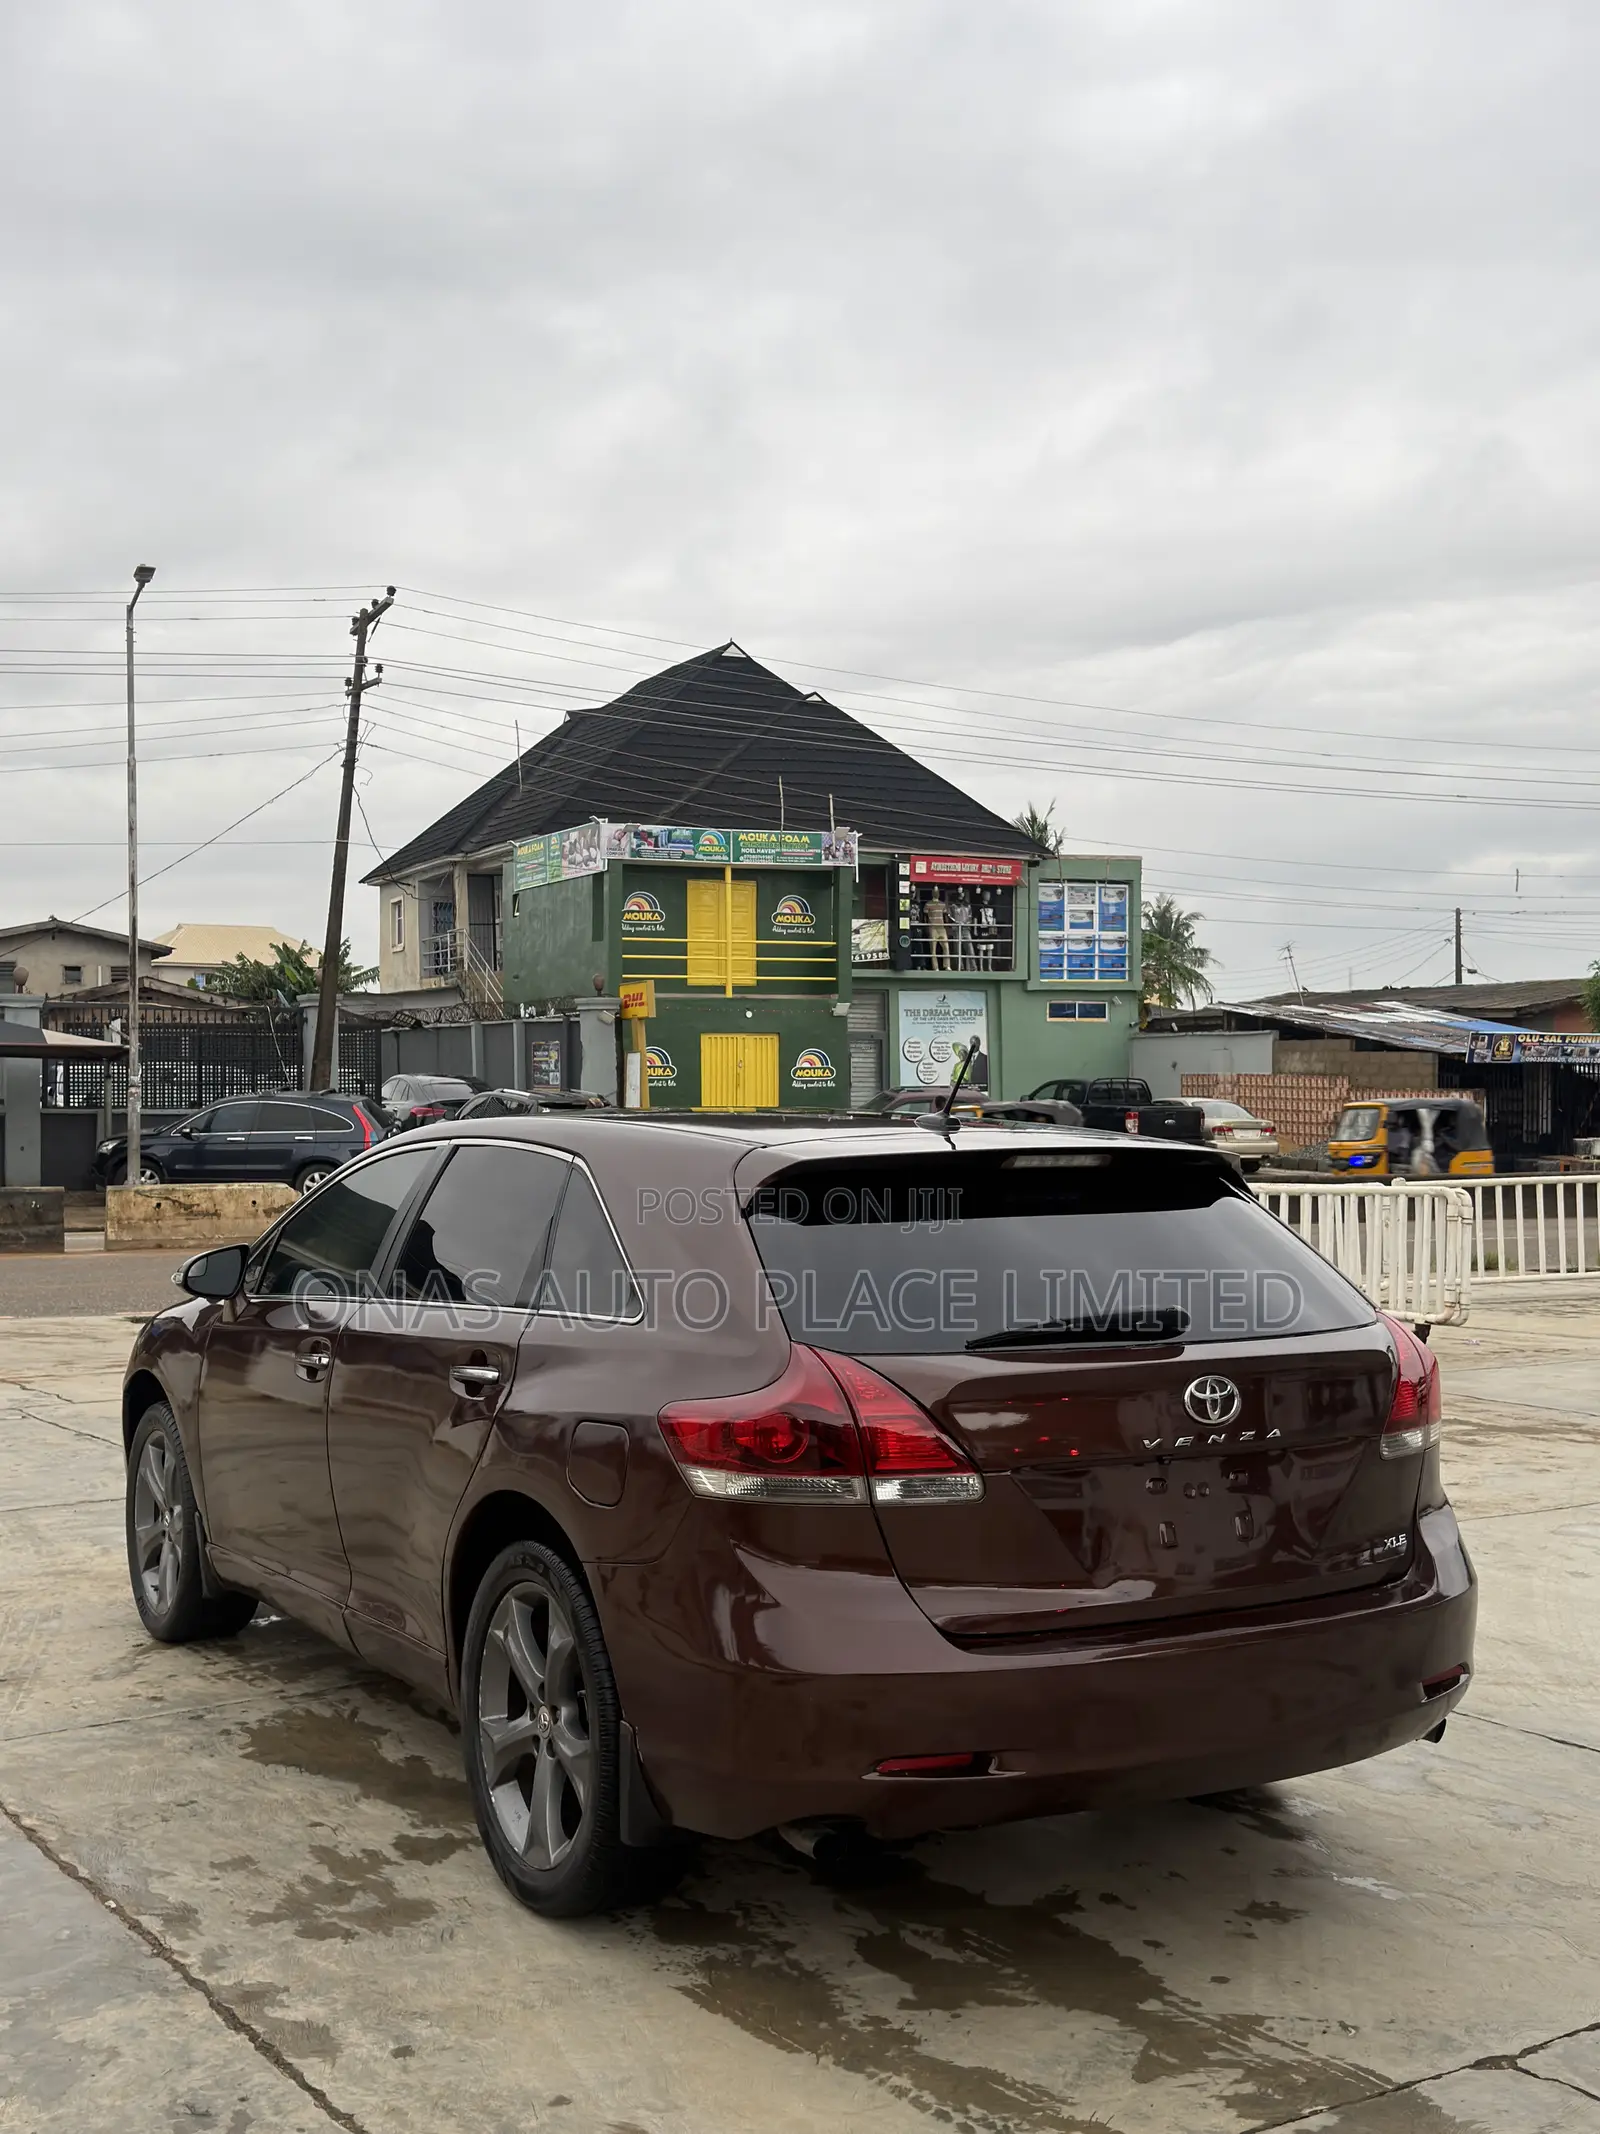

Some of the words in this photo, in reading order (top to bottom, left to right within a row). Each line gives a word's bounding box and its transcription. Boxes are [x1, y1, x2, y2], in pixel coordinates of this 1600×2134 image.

[738, 833, 777, 842] MOUKA
[779, 834, 810, 843] FOAM
[623, 912, 661, 921] MOUKA
[775, 915, 811, 923] MOUKA
[623, 992, 645, 1009] DHL
[904, 1009, 921, 1017] THE
[922, 1009, 951, 1017] DREAM
[952, 1008, 984, 1017] CENTRE
[1518, 1034, 1562, 1043] OLU-SAL
[795, 1069, 832, 1077] MOUKA
[1142, 1428, 1282, 1450] VENZA
[1383, 1533, 1407, 1550] XLE
